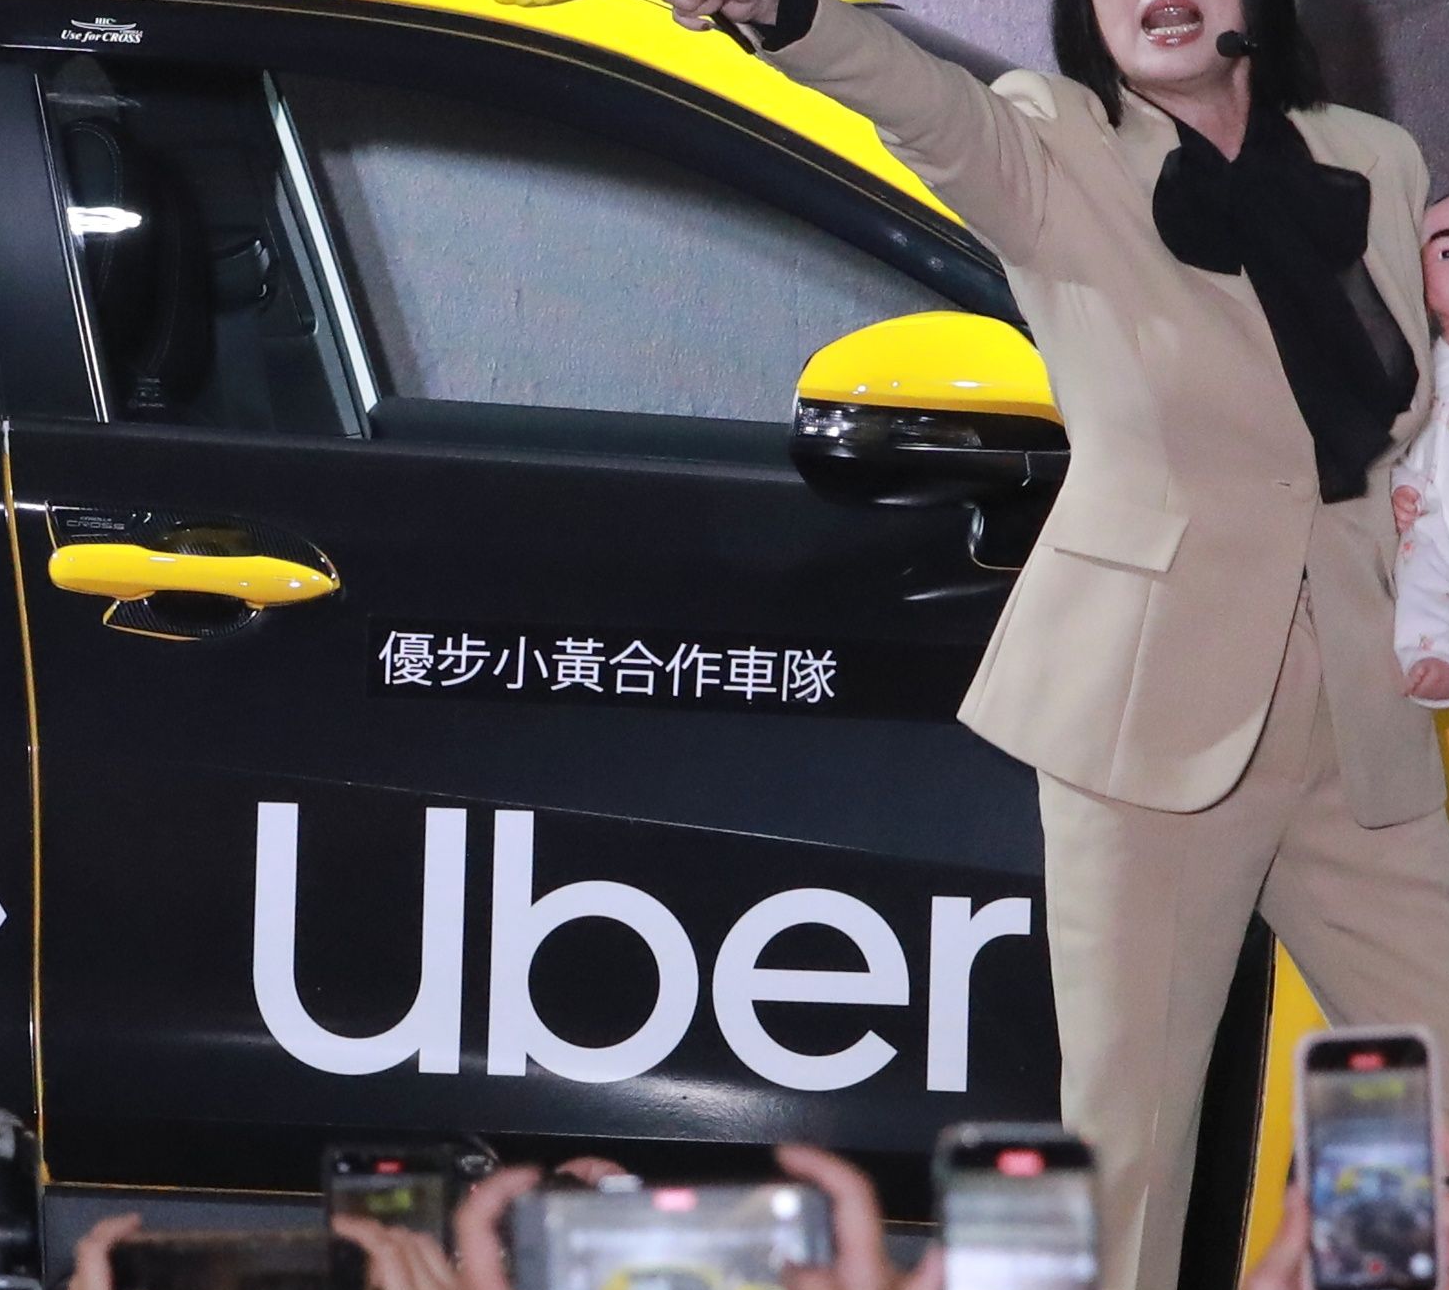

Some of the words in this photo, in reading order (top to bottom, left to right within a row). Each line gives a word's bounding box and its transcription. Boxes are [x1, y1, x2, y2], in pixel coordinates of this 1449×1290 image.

[61, 29, 83, 40] Use
[81, 31, 102, 43] for
[102, 31, 142, 44] CROSS
[378, 629, 838, 705] 優步小黃合作車隊
[253, 801, 1032, 1093] Uber
